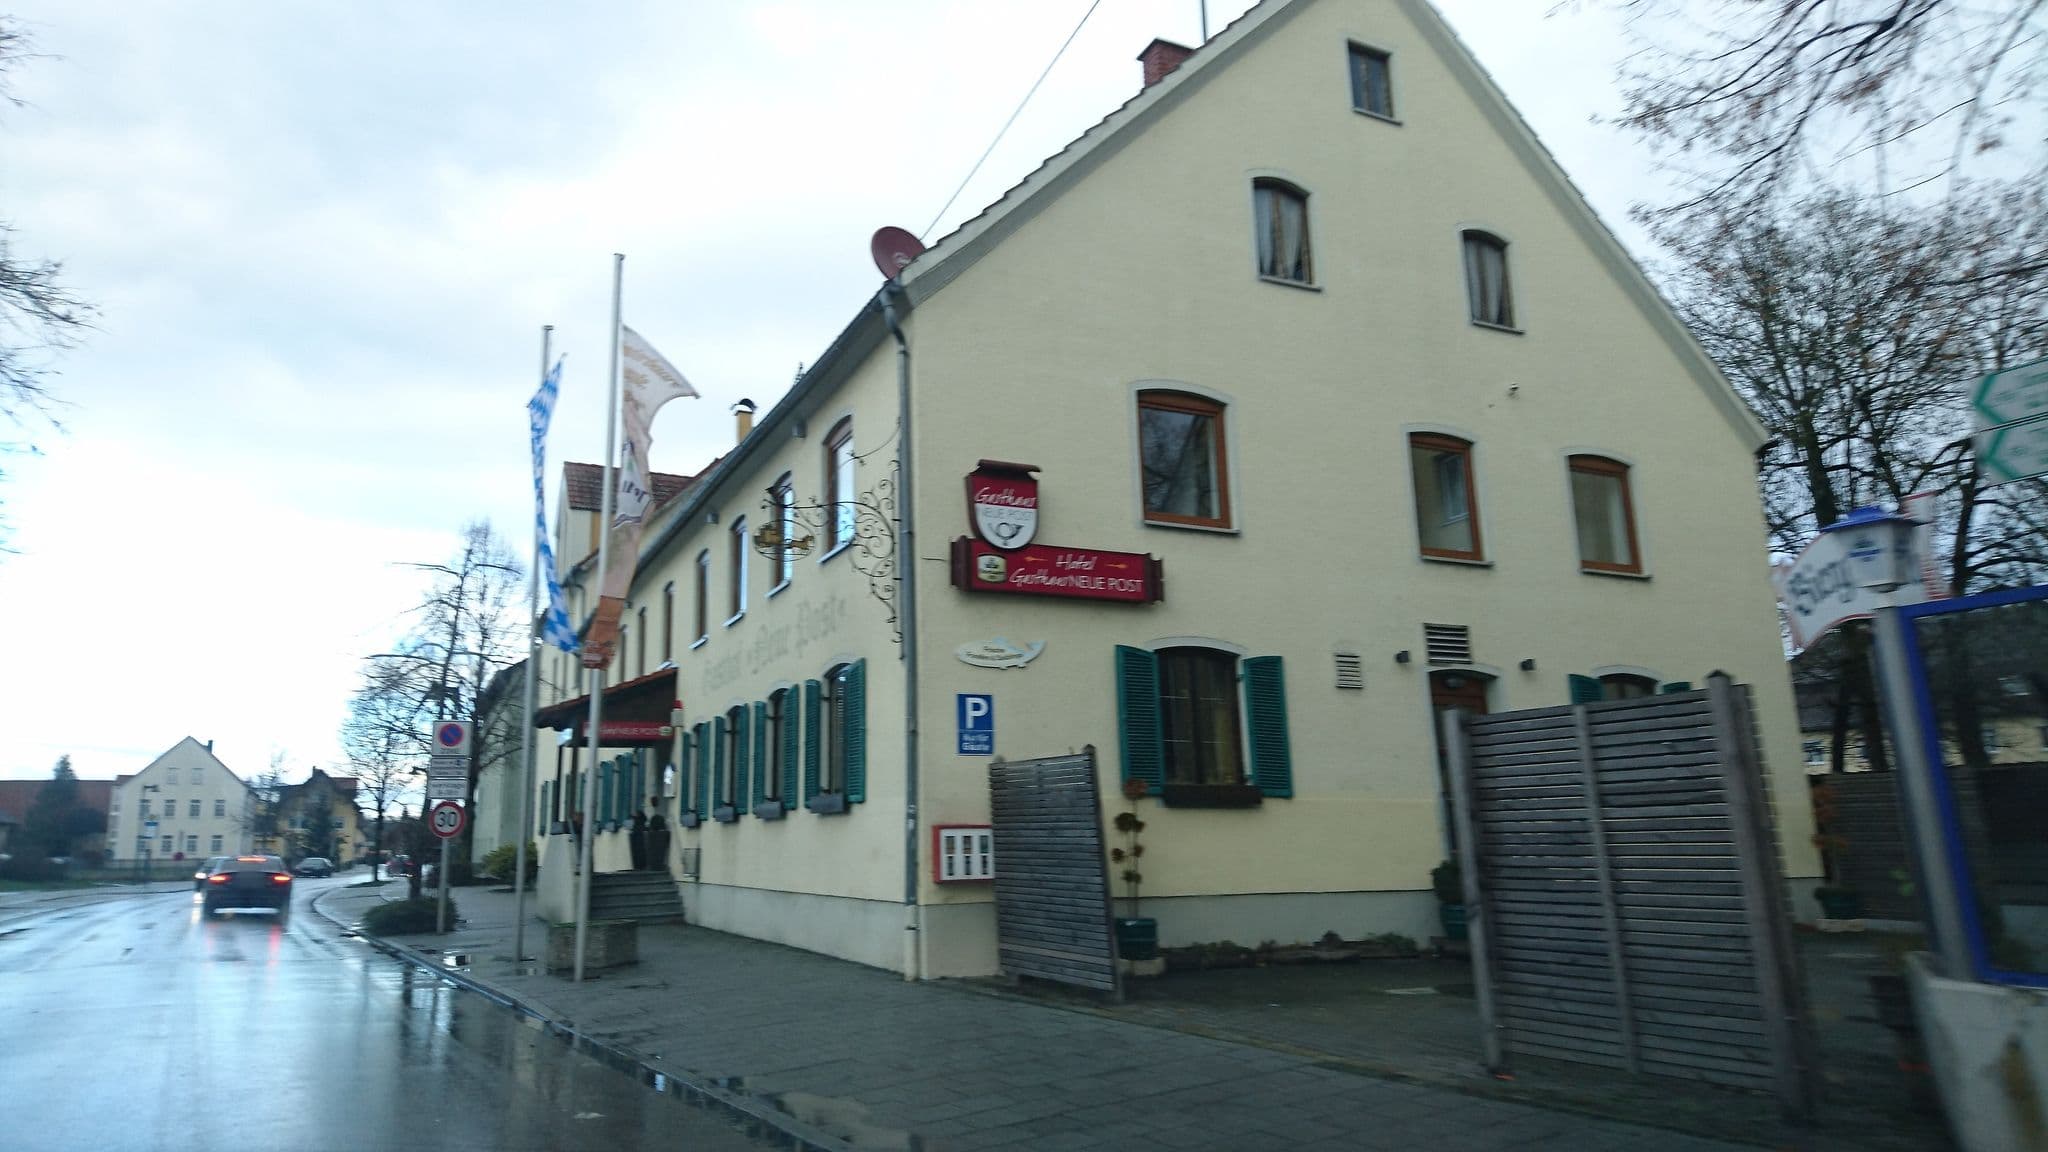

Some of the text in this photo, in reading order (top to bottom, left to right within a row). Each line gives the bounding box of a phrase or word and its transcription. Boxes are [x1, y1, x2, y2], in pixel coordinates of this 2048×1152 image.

[1055, 553, 1097, 571] Hotel
[1068, 574, 1105, 590] NEUE
[1107, 577, 1144, 593] POST
[965, 697, 989, 729] P
[436, 811, 458, 828] 30
